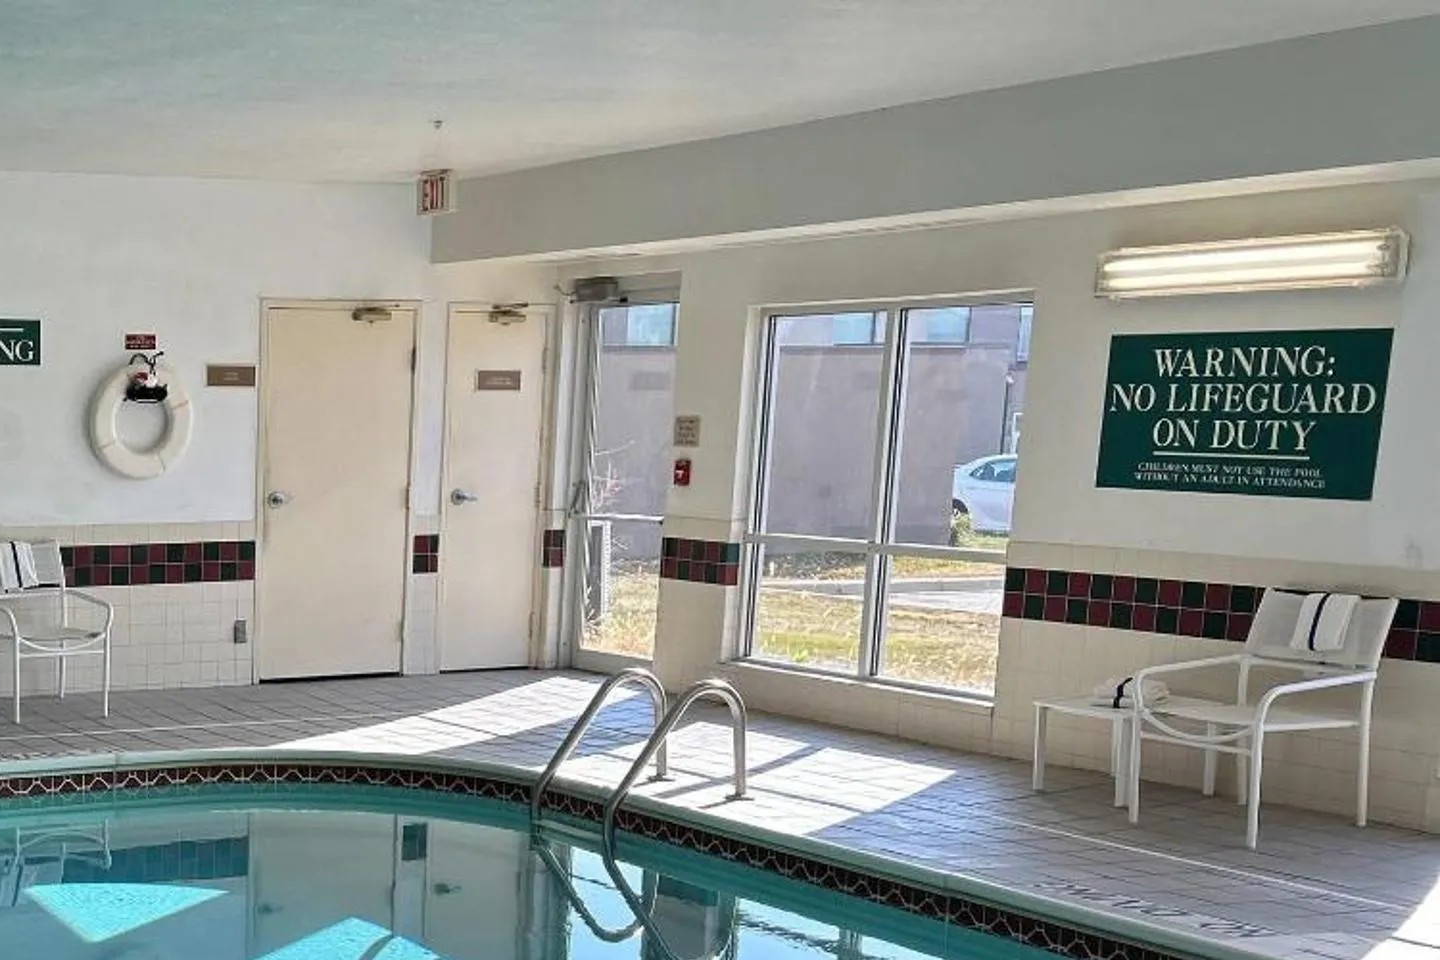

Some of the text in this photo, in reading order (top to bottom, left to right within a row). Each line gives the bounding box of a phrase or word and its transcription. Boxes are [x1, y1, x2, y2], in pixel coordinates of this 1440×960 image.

[422, 176, 446, 210] EXIT
[1155, 345, 1335, 378] WARNING:
[1110, 383, 1377, 414] NO LIFEGUARD
[1153, 418, 1317, 450] ON DUTY
